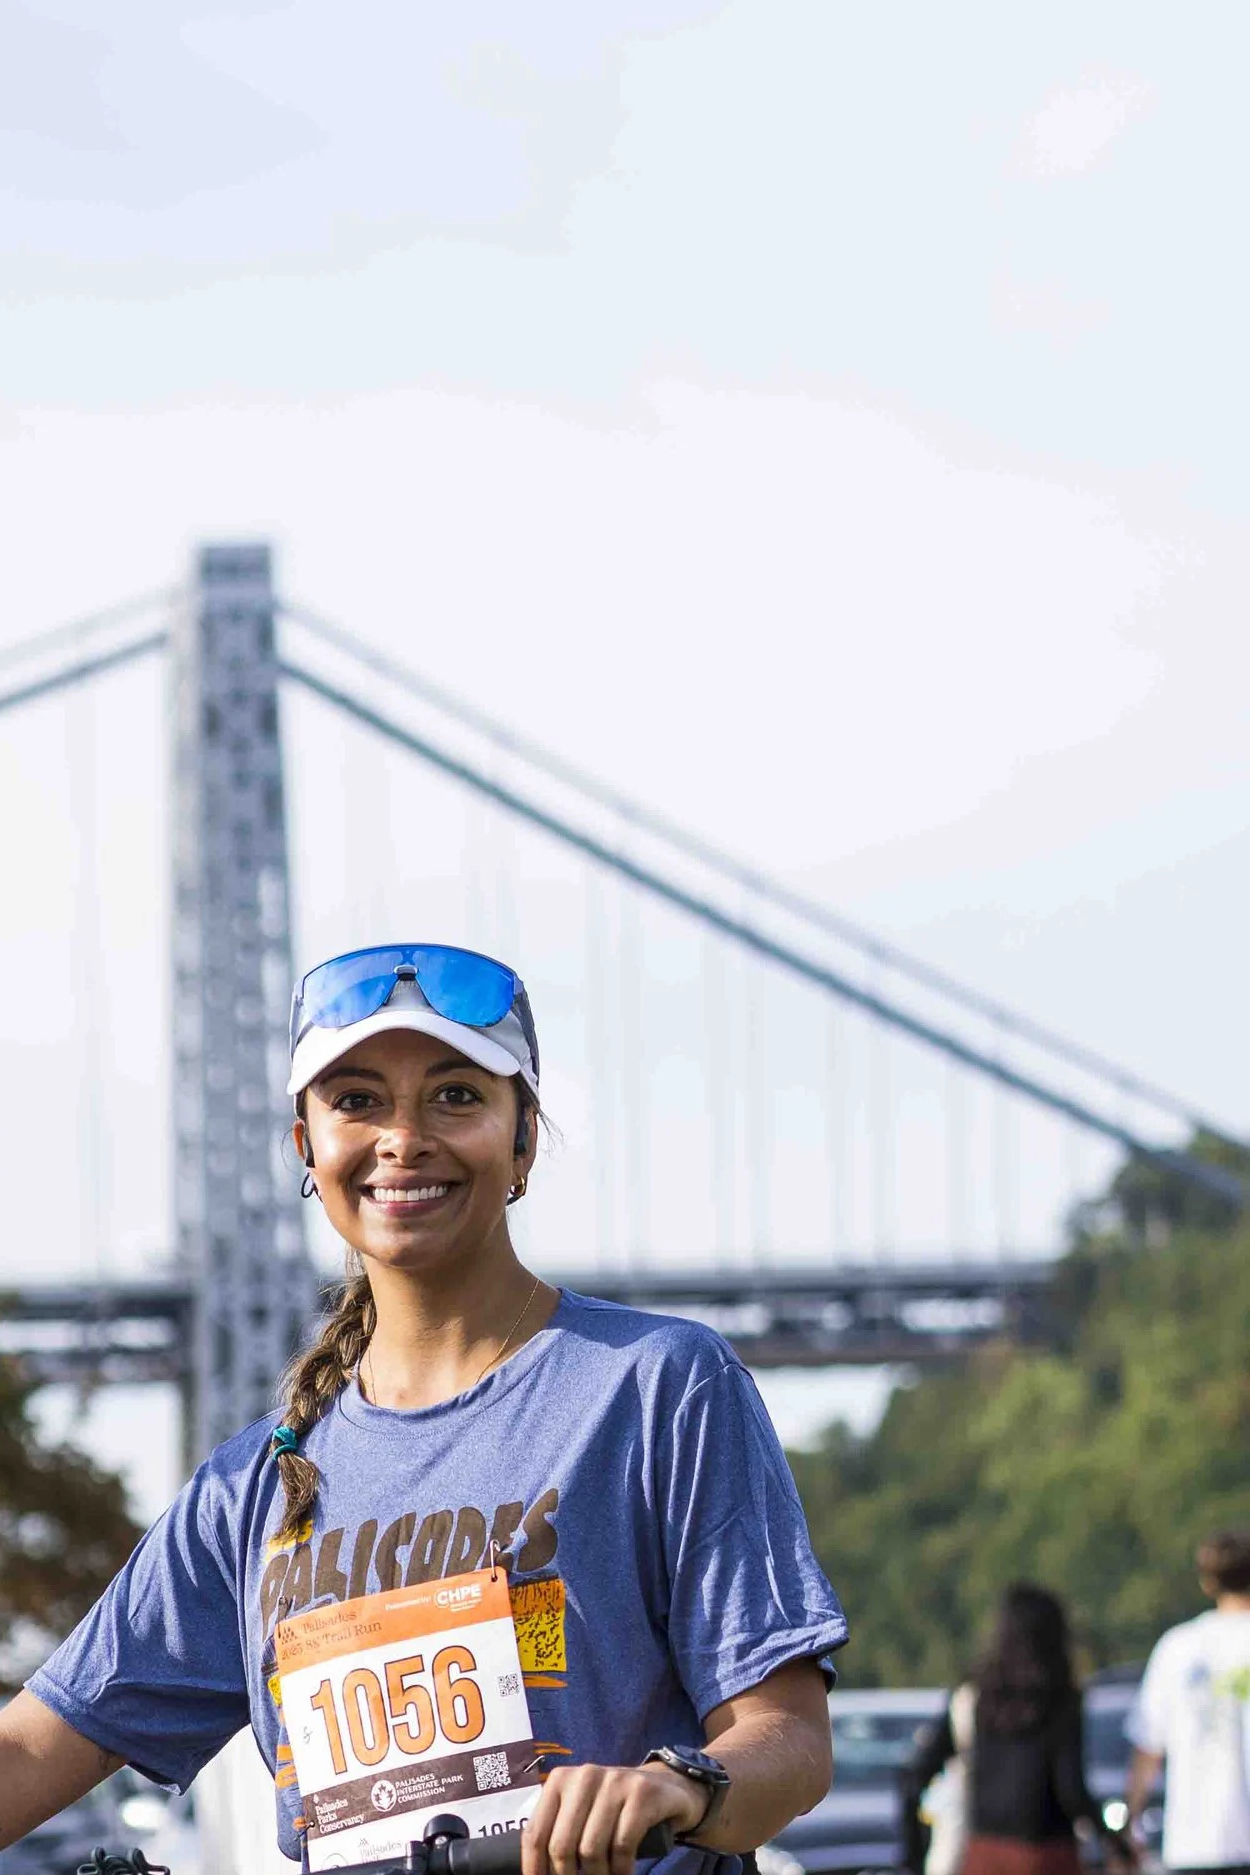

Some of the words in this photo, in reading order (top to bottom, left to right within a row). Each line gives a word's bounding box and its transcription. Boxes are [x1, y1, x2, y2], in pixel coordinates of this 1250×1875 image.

[260, 1487, 558, 1642] PALISADES
[436, 1583, 481, 1606] CHPE
[302, 1611, 357, 1634] Palisades
[322, 1627, 351, 1643] Trail
[354, 1622, 382, 1636] Run
[310, 1645, 485, 1775] 1056
[395, 1773, 435, 1788] PALISADES
[396, 1780, 439, 1796] INTERSTATE
[441, 1774, 464, 1785] PARK
[397, 1786, 446, 1803] COMMISSION
[315, 1798, 348, 1815] Palisades
[317, 1811, 338, 1825] Parks
[319, 1814, 365, 1834] Conservancy
